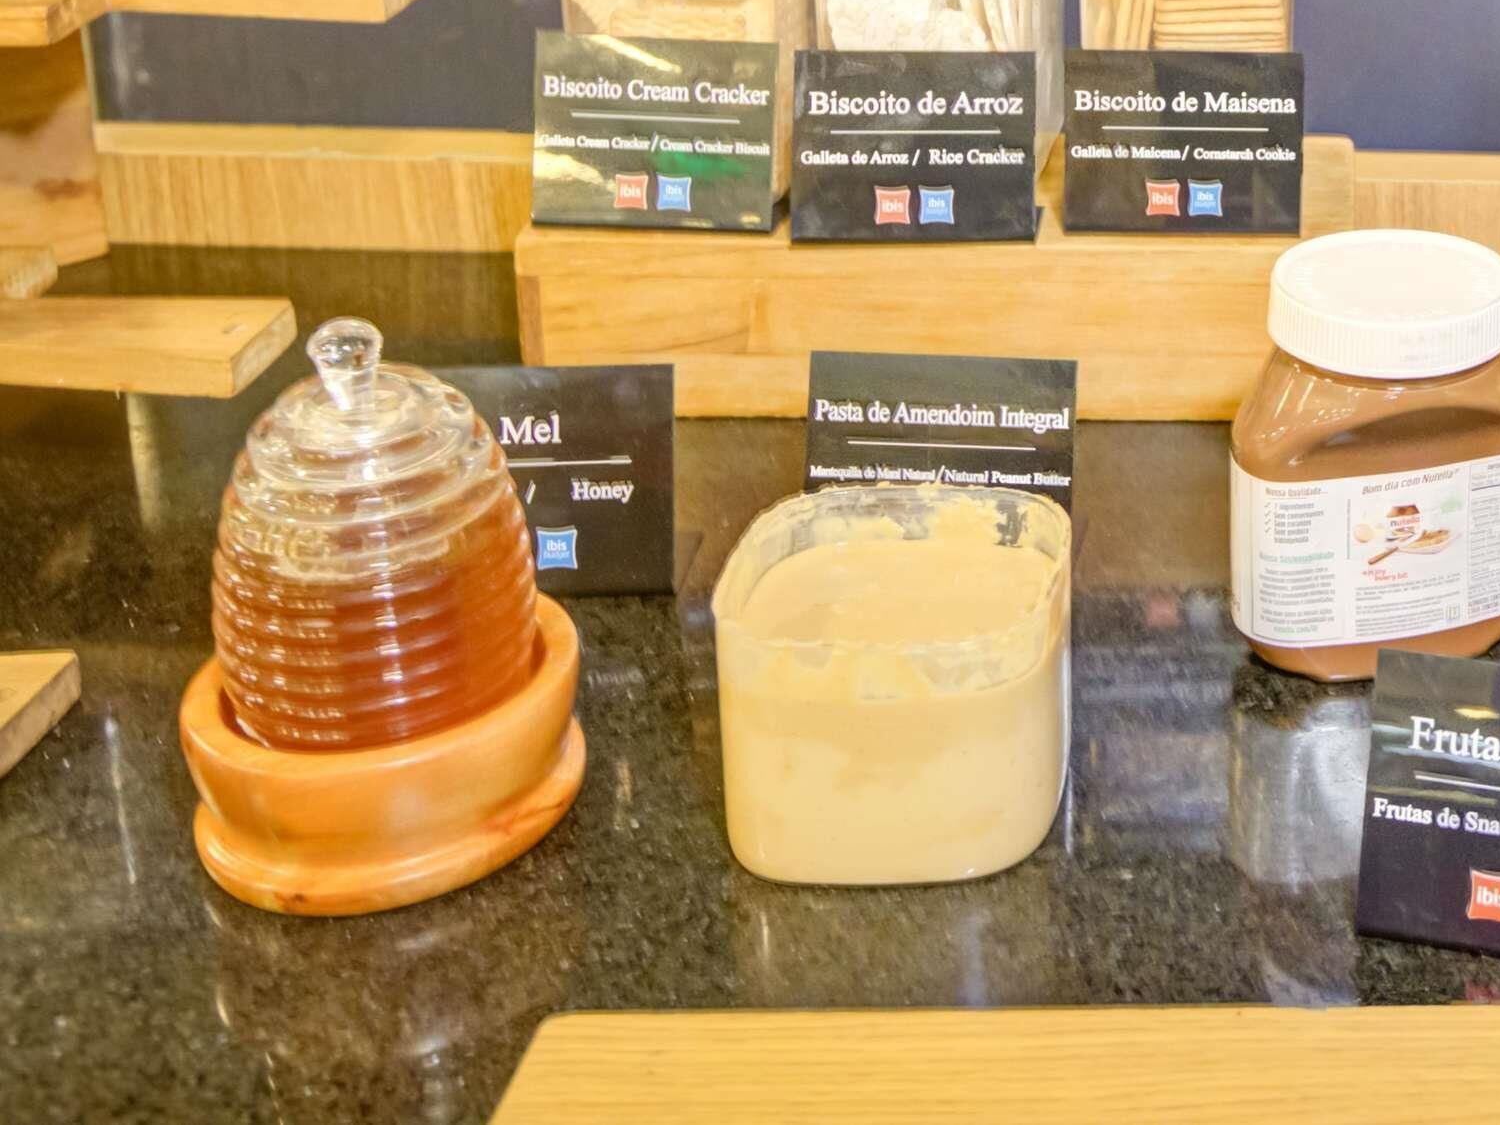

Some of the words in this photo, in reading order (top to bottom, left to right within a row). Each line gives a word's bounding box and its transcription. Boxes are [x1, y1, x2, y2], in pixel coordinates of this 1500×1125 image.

[543, 75, 622, 100] Biscoito
[627, 79, 689, 103] Cream
[694, 82, 770, 106] Cracker
[809, 90, 911, 116] Biscoito
[917, 91, 947, 115] de
[951, 91, 1024, 116] Arroz
[1074, 90, 1166, 112] Biscoito
[1172, 91, 1198, 112] de
[1203, 92, 1296, 114] Maisena
[577, 136, 609, 150] Cream
[611, 137, 650, 151] Cracker
[660, 139, 693, 153] Cream
[695, 140, 733, 154] Cracker
[735, 142, 770, 156] Biscuit
[801, 149, 849, 165] Galleta
[851, 149, 868, 165] de
[870, 150, 909, 165] Arroz
[929, 149, 963, 165] Rice
[967, 148, 1025, 165] Cracker
[1071, 145, 1113, 159] Galleta
[1115, 144, 1129, 159] de
[1193, 147, 1254, 161] Cornstarch
[1256, 146, 1296, 161] Cookie
[620, 186, 641, 198] ibis
[665, 184, 683, 196] ibis
[1152, 194, 1174, 205] ibis
[1197, 192, 1214, 202] ibis
[814, 399, 863, 423] Pasta
[868, 401, 890, 423] de
[894, 402, 996, 427] Amendoim
[1000, 406, 1070, 434] Integral
[500, 413, 562, 445] Mel
[810, 465, 862, 482] Mantequilla
[863, 467, 875, 480] de
[903, 468, 935, 482] Natural
[945, 469, 990, 484] Natural
[991, 471, 1031, 485] Peanut
[1033, 471, 1071, 487] Butter
[571, 479, 634, 505] Honey
[546, 541, 567, 552] ibis
[1372, 797, 1432, 825] Frutas
[1436, 807, 1461, 830] de
